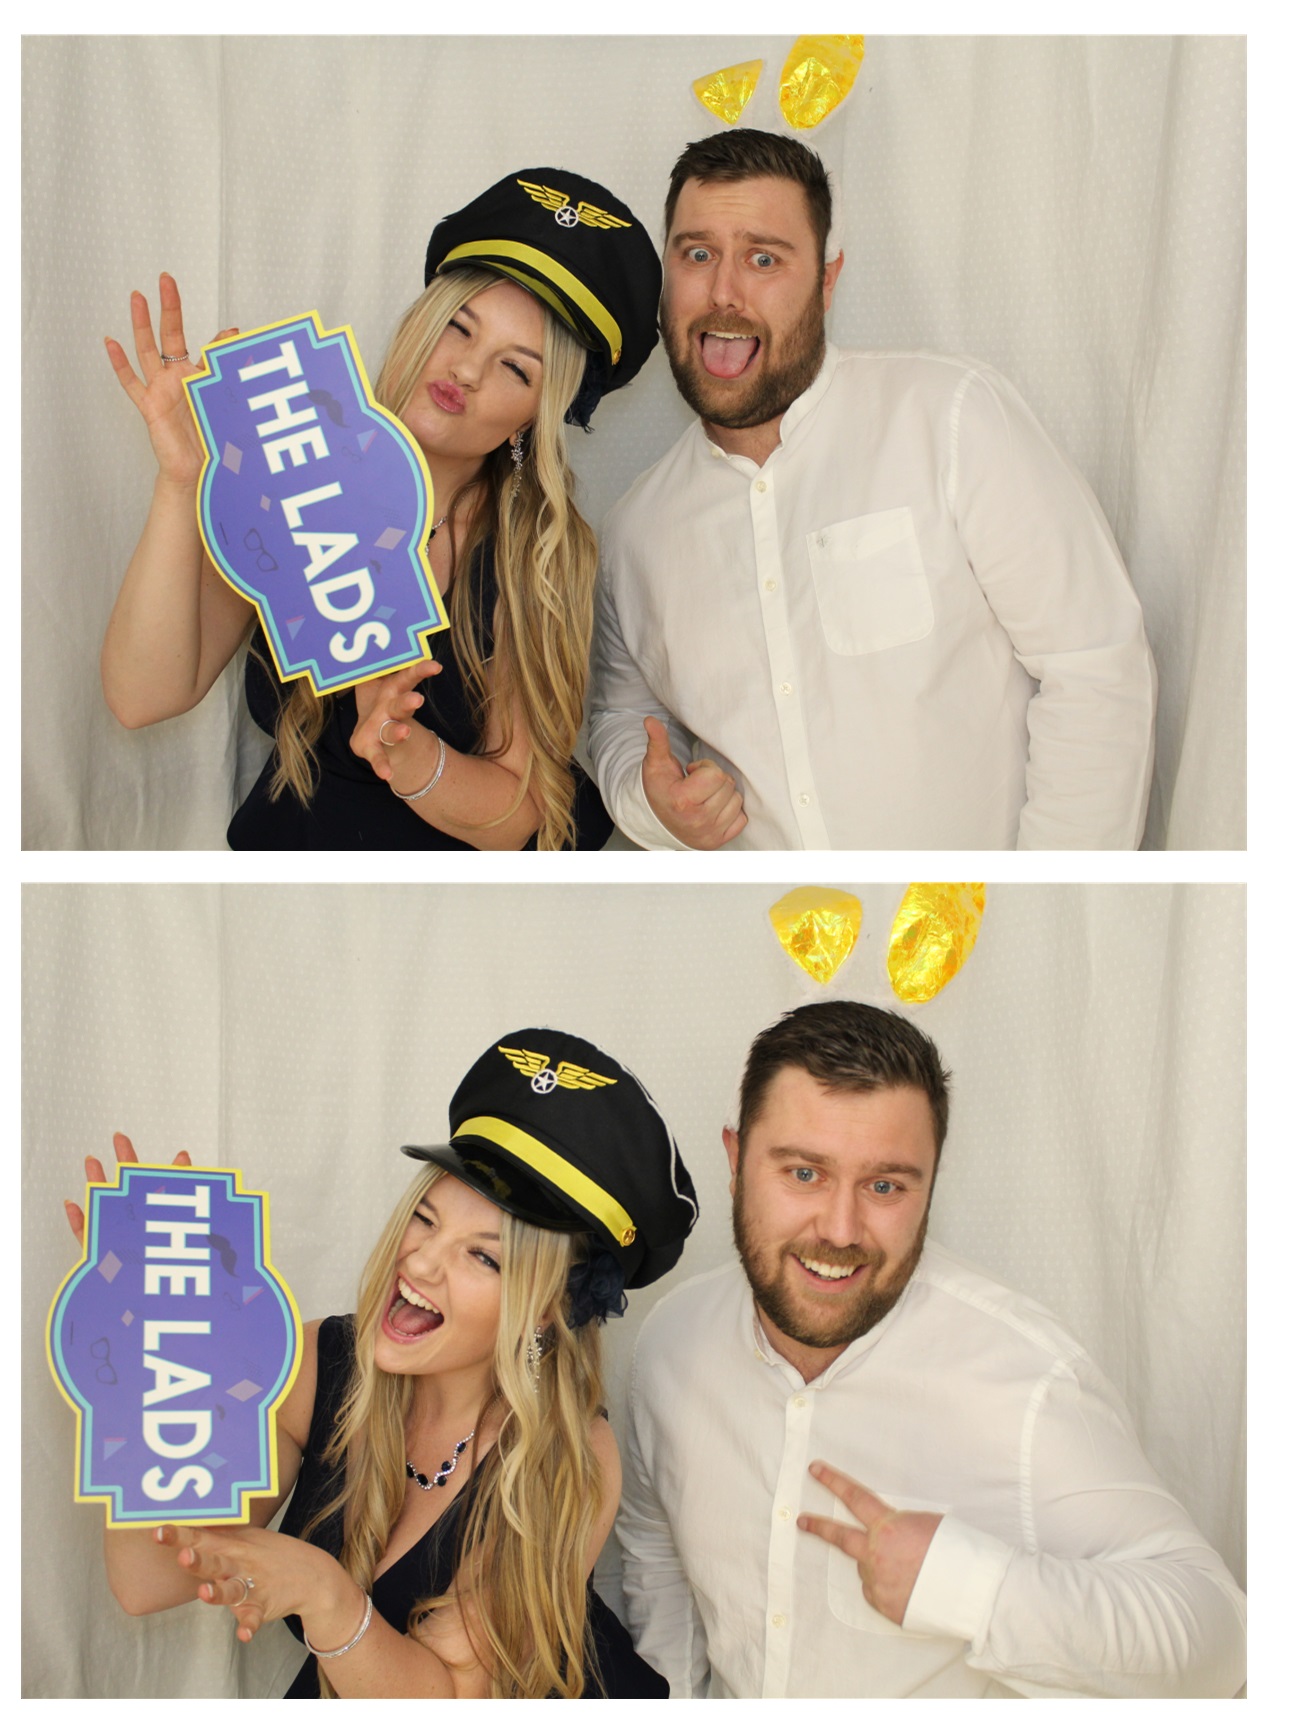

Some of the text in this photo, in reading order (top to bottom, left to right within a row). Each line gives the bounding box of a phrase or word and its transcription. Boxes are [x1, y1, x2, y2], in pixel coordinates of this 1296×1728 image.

[237, 339, 392, 664] THE LADS
[140, 1184, 215, 1503] THE LADS
